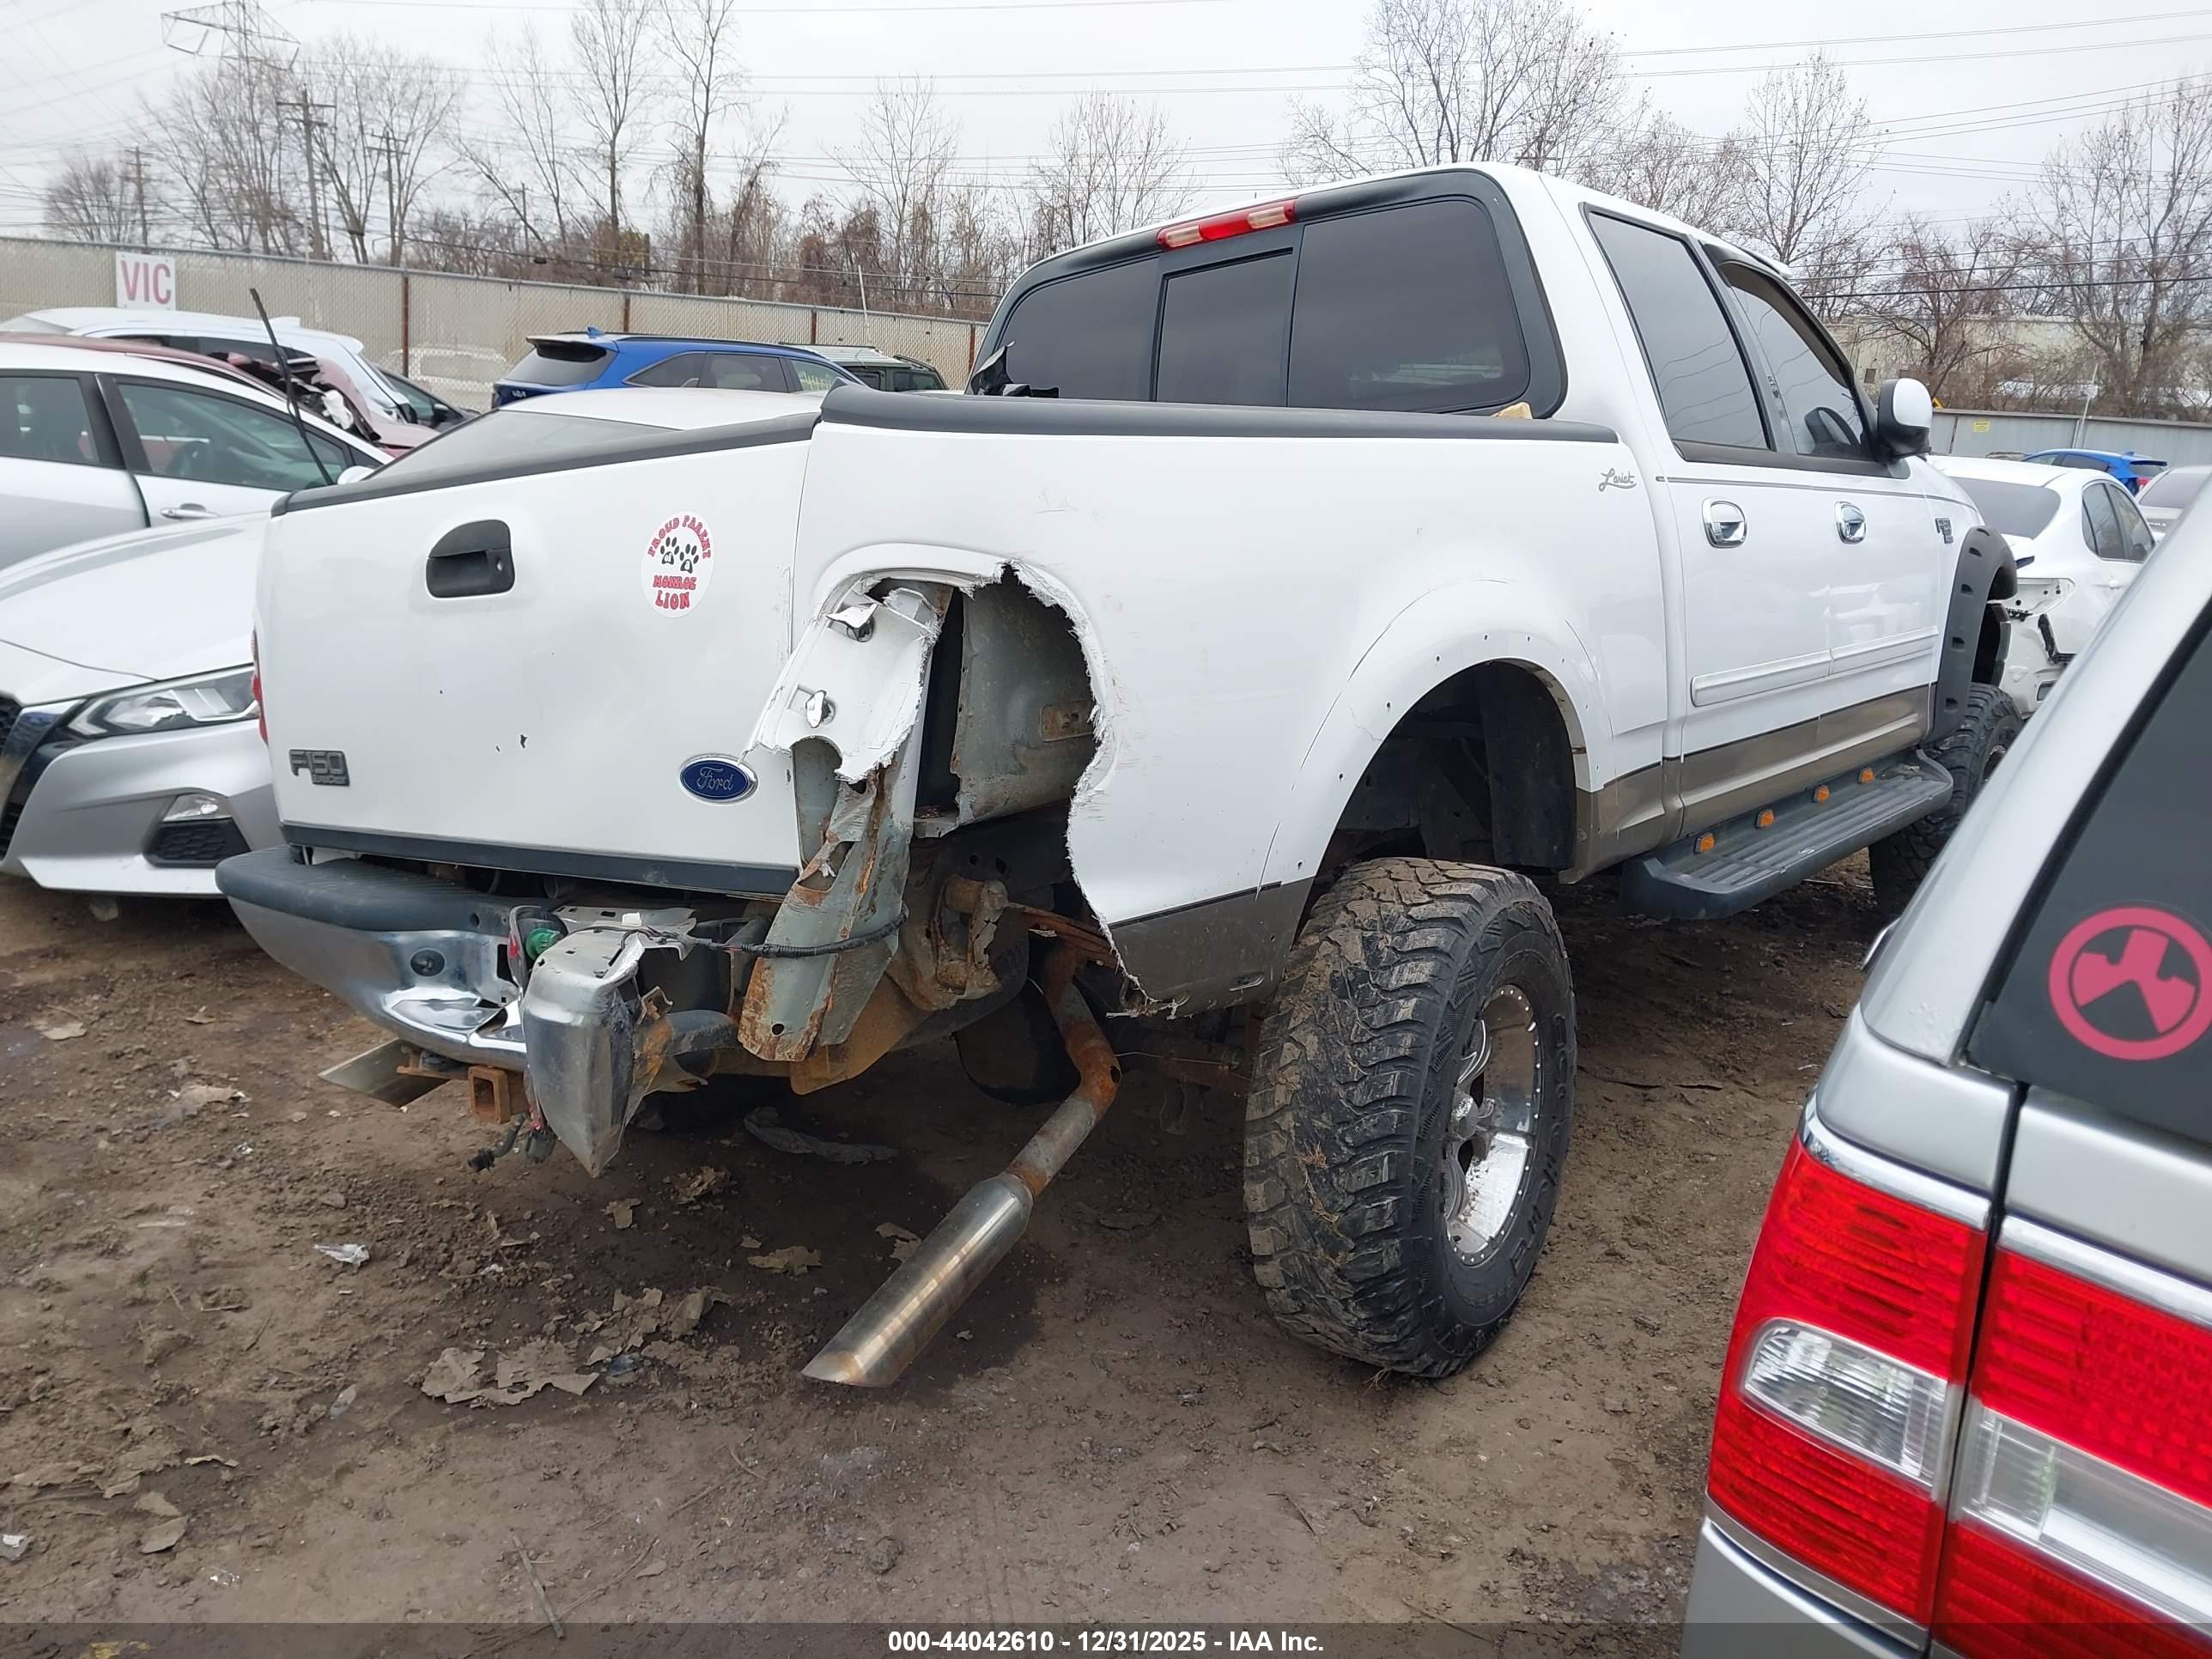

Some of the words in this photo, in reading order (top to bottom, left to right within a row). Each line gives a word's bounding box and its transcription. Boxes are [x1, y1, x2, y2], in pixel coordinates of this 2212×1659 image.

[120, 259, 172, 305] VIC
[1598, 467, 1638, 492] Lariat
[647, 517, 680, 557] PROUD
[682, 515, 712, 559] PARENT
[653, 574, 697, 590] MONROE
[655, 590, 690, 610] LION
[696, 766, 735, 791] Ford
